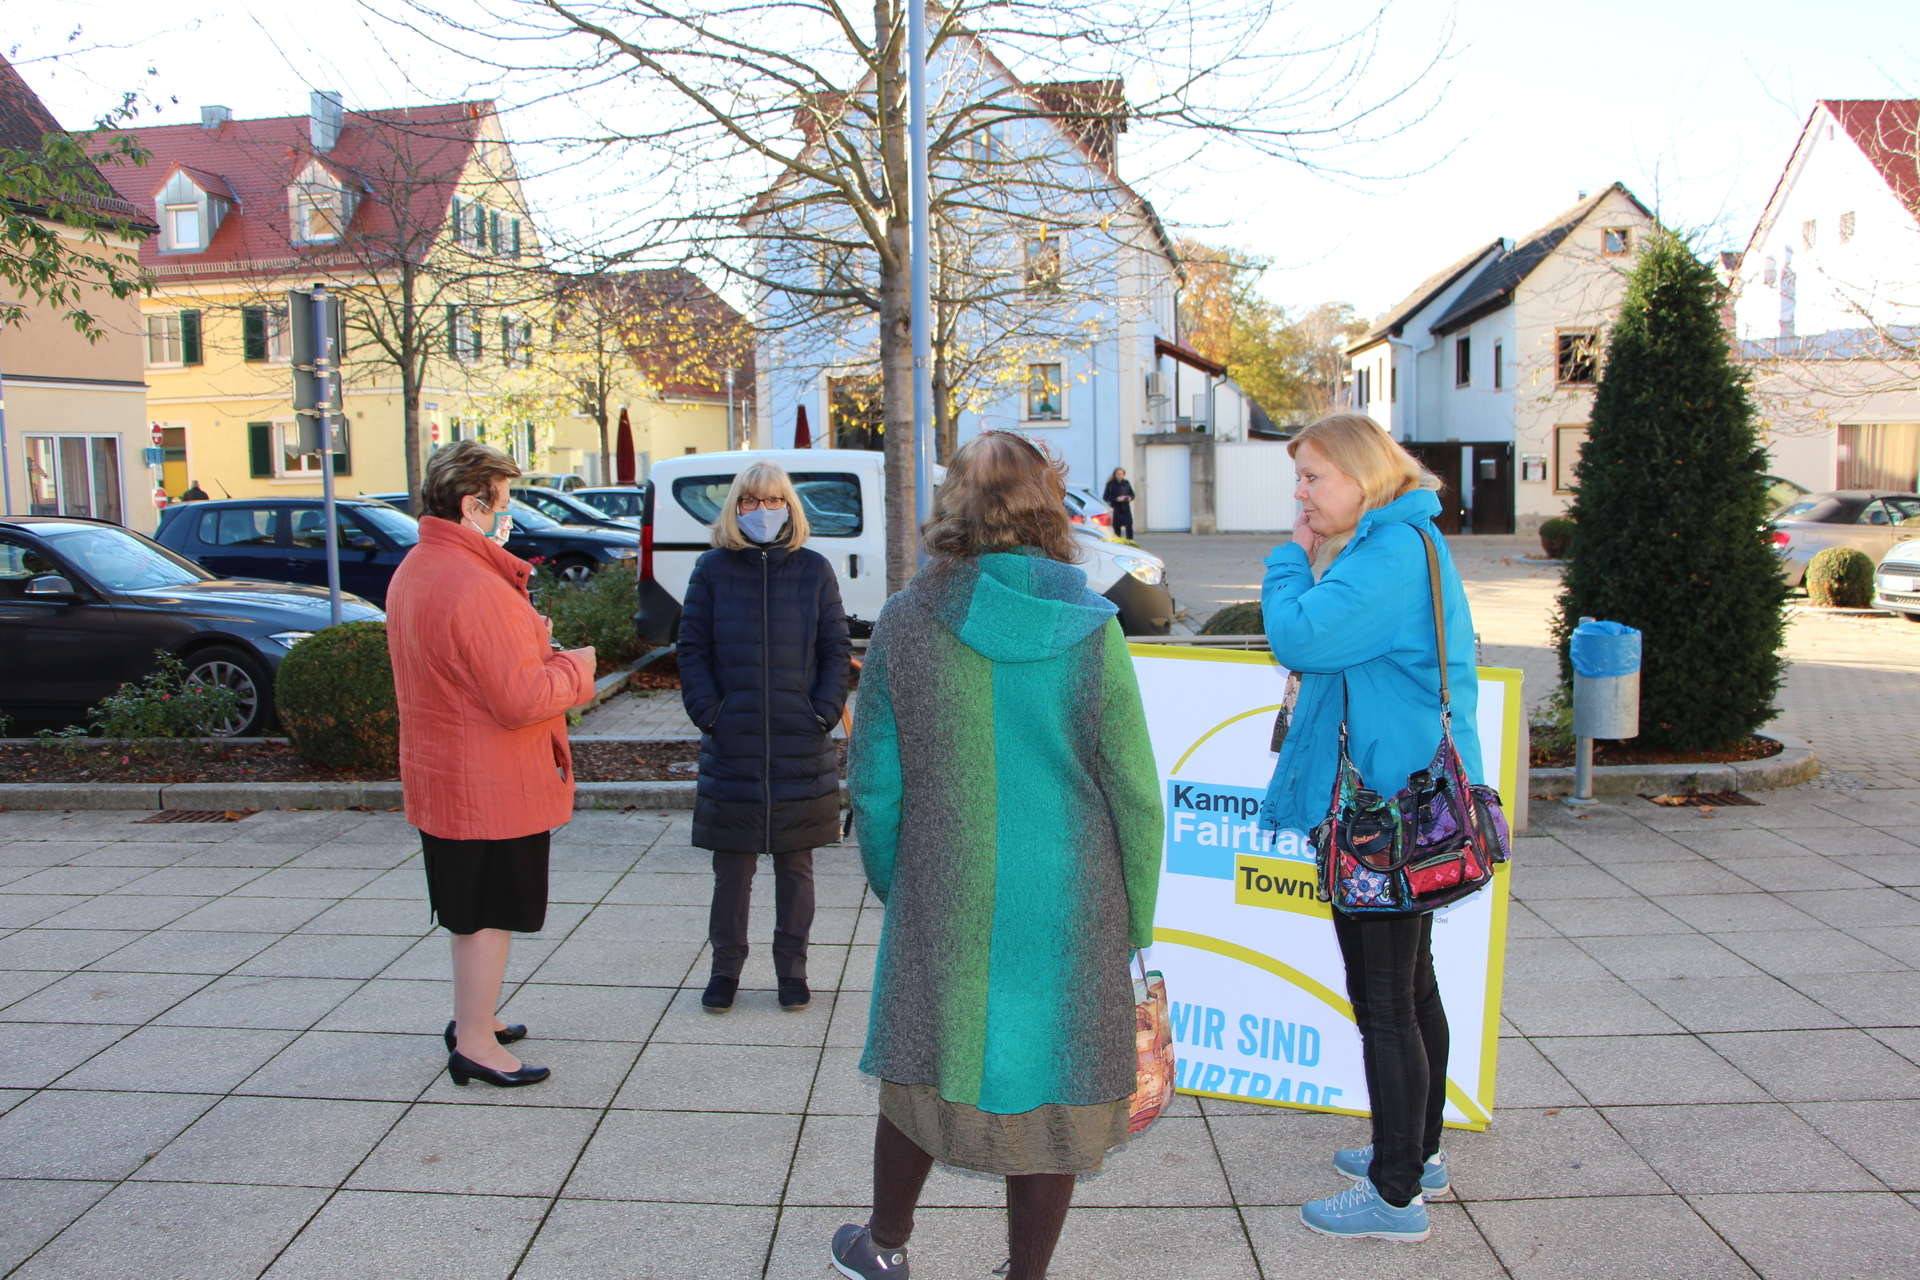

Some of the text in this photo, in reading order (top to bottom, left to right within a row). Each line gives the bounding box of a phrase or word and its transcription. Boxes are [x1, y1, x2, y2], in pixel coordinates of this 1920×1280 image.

[915, 356, 931, 368] 12
[1169, 1001, 1321, 1068] WIR SIND
